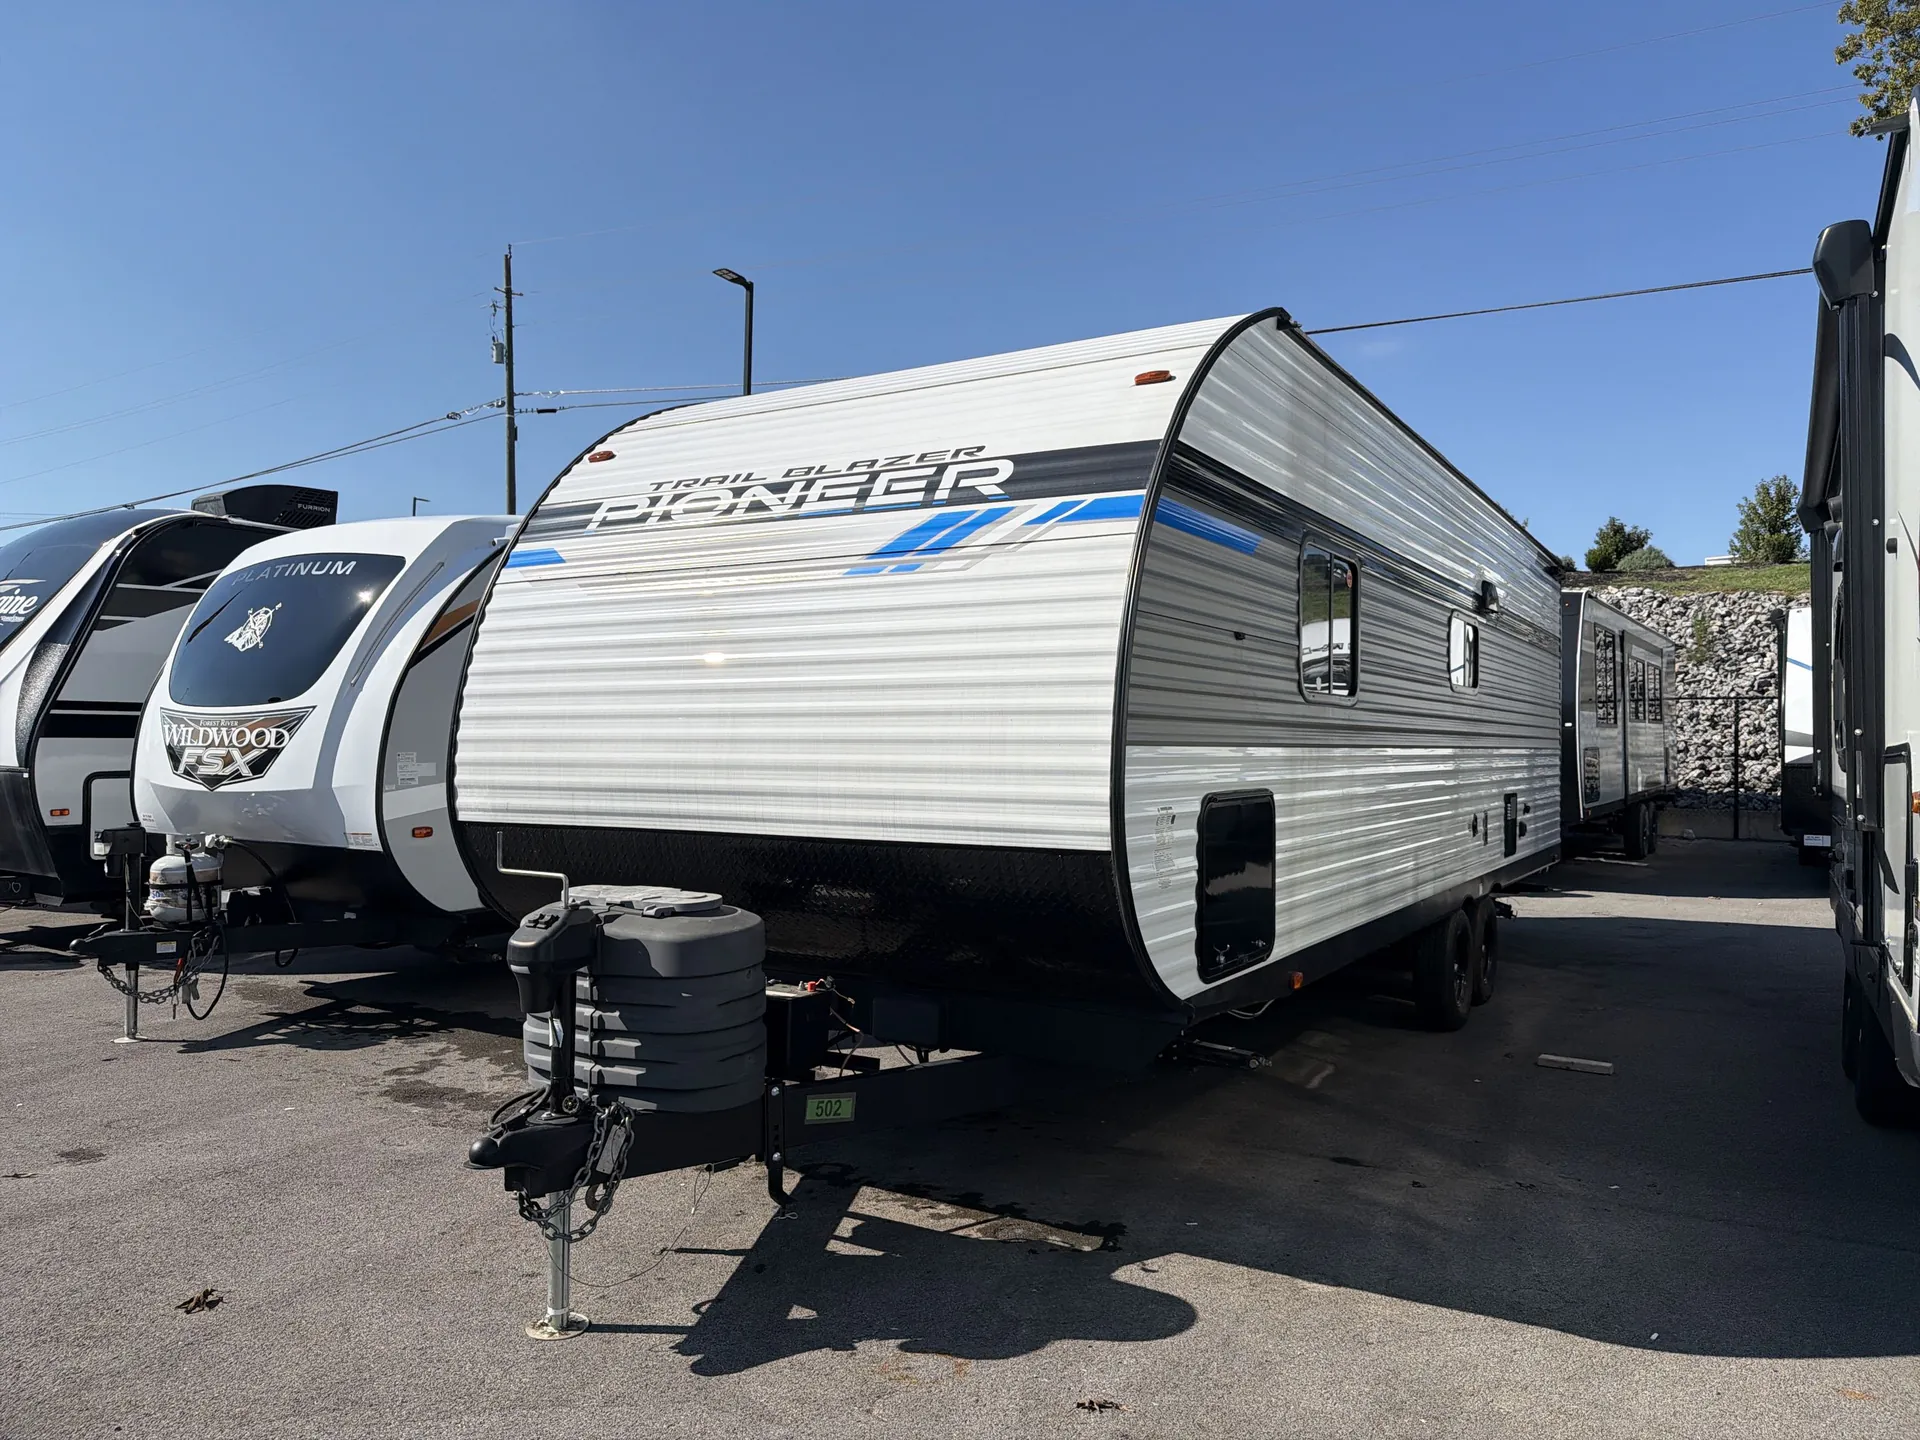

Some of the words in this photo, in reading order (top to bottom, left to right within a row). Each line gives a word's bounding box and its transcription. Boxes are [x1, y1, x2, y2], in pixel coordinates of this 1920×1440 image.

[650, 472, 767, 492] TRAIL
[781, 445, 986, 479] BLAZER
[297, 503, 331, 513] FURRION
[584, 459, 1014, 534] PIONEER
[231, 561, 357, 586] PLATINUM
[199, 719, 220, 727] FOREST
[220, 718, 239, 727] RIVER
[163, 724, 290, 748] WILDWOOD
[177, 747, 268, 777] FSX
[815, 1099, 842, 1118] 502
